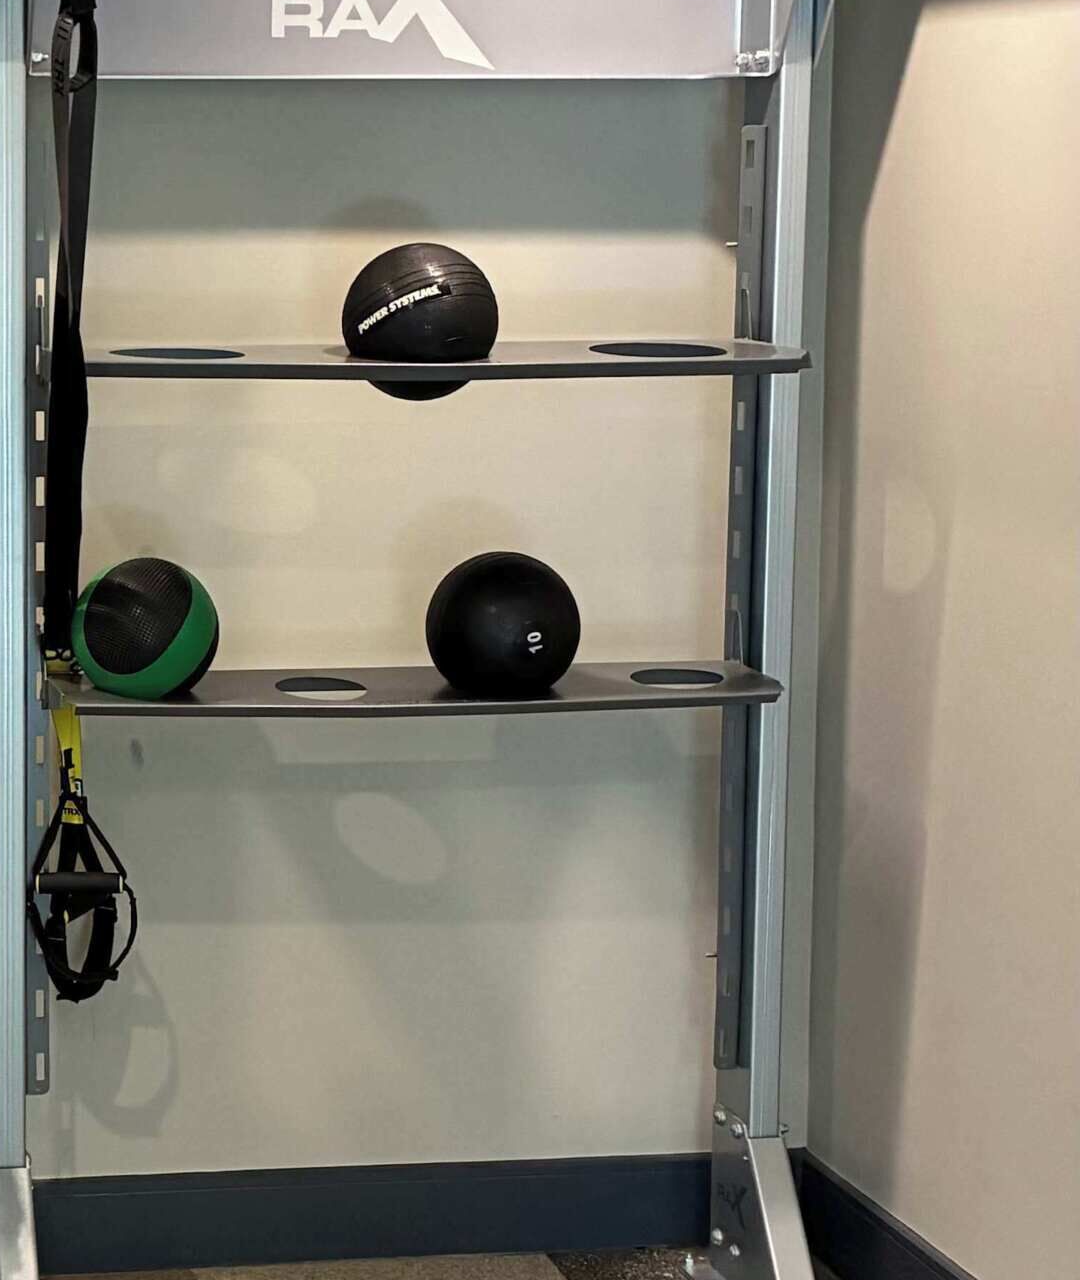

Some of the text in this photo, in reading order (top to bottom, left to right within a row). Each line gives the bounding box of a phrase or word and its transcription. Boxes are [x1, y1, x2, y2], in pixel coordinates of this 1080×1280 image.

[357, 284, 442, 335] POWER SYSTEMS
[526, 631, 543, 654] 10
